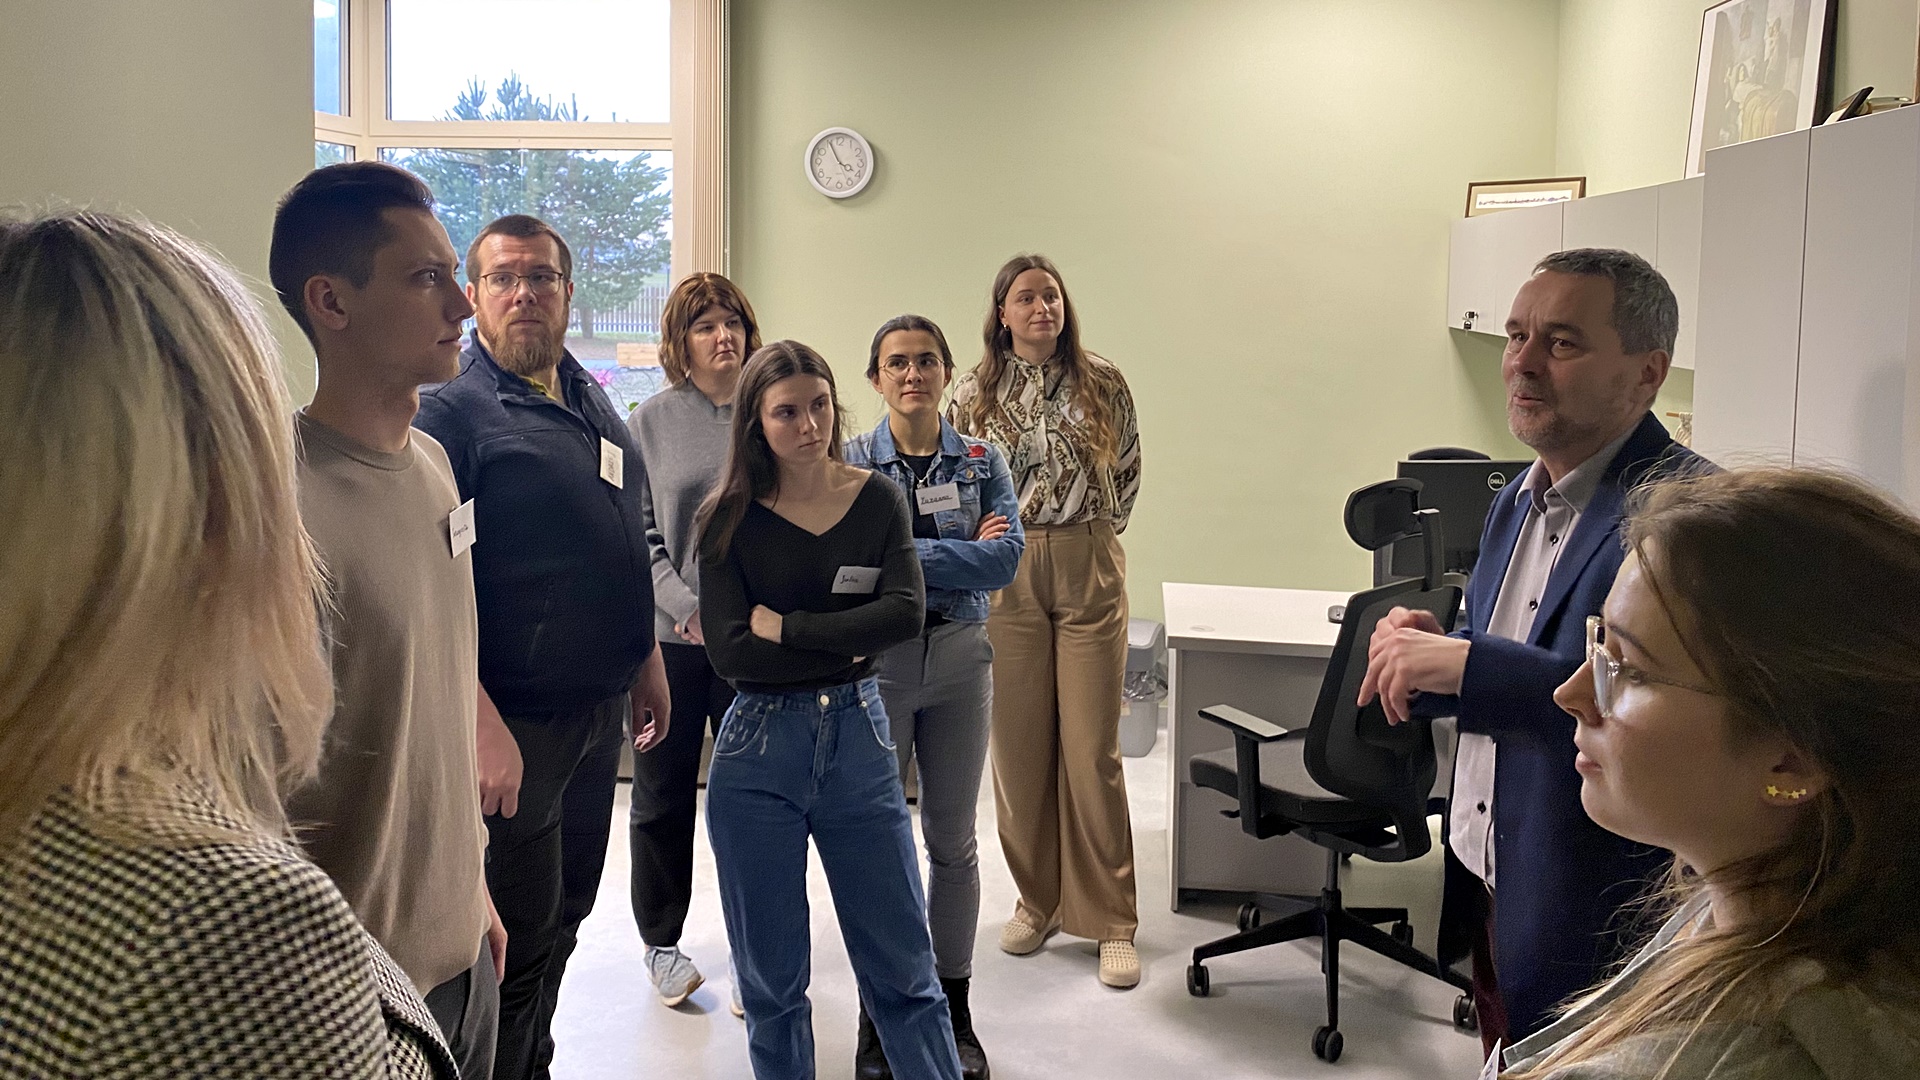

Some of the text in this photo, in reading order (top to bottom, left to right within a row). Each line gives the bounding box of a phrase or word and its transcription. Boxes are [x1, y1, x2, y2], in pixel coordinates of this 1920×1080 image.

[836, 136, 844, 146] 12
[854, 148, 862, 157] 2
[814, 158, 822, 167] 9
[856, 158, 864, 168] 3
[818, 168, 824, 178] 8
[854, 170, 860, 179] 4
[826, 176, 832, 186] 7
[836, 180, 842, 190] 6
